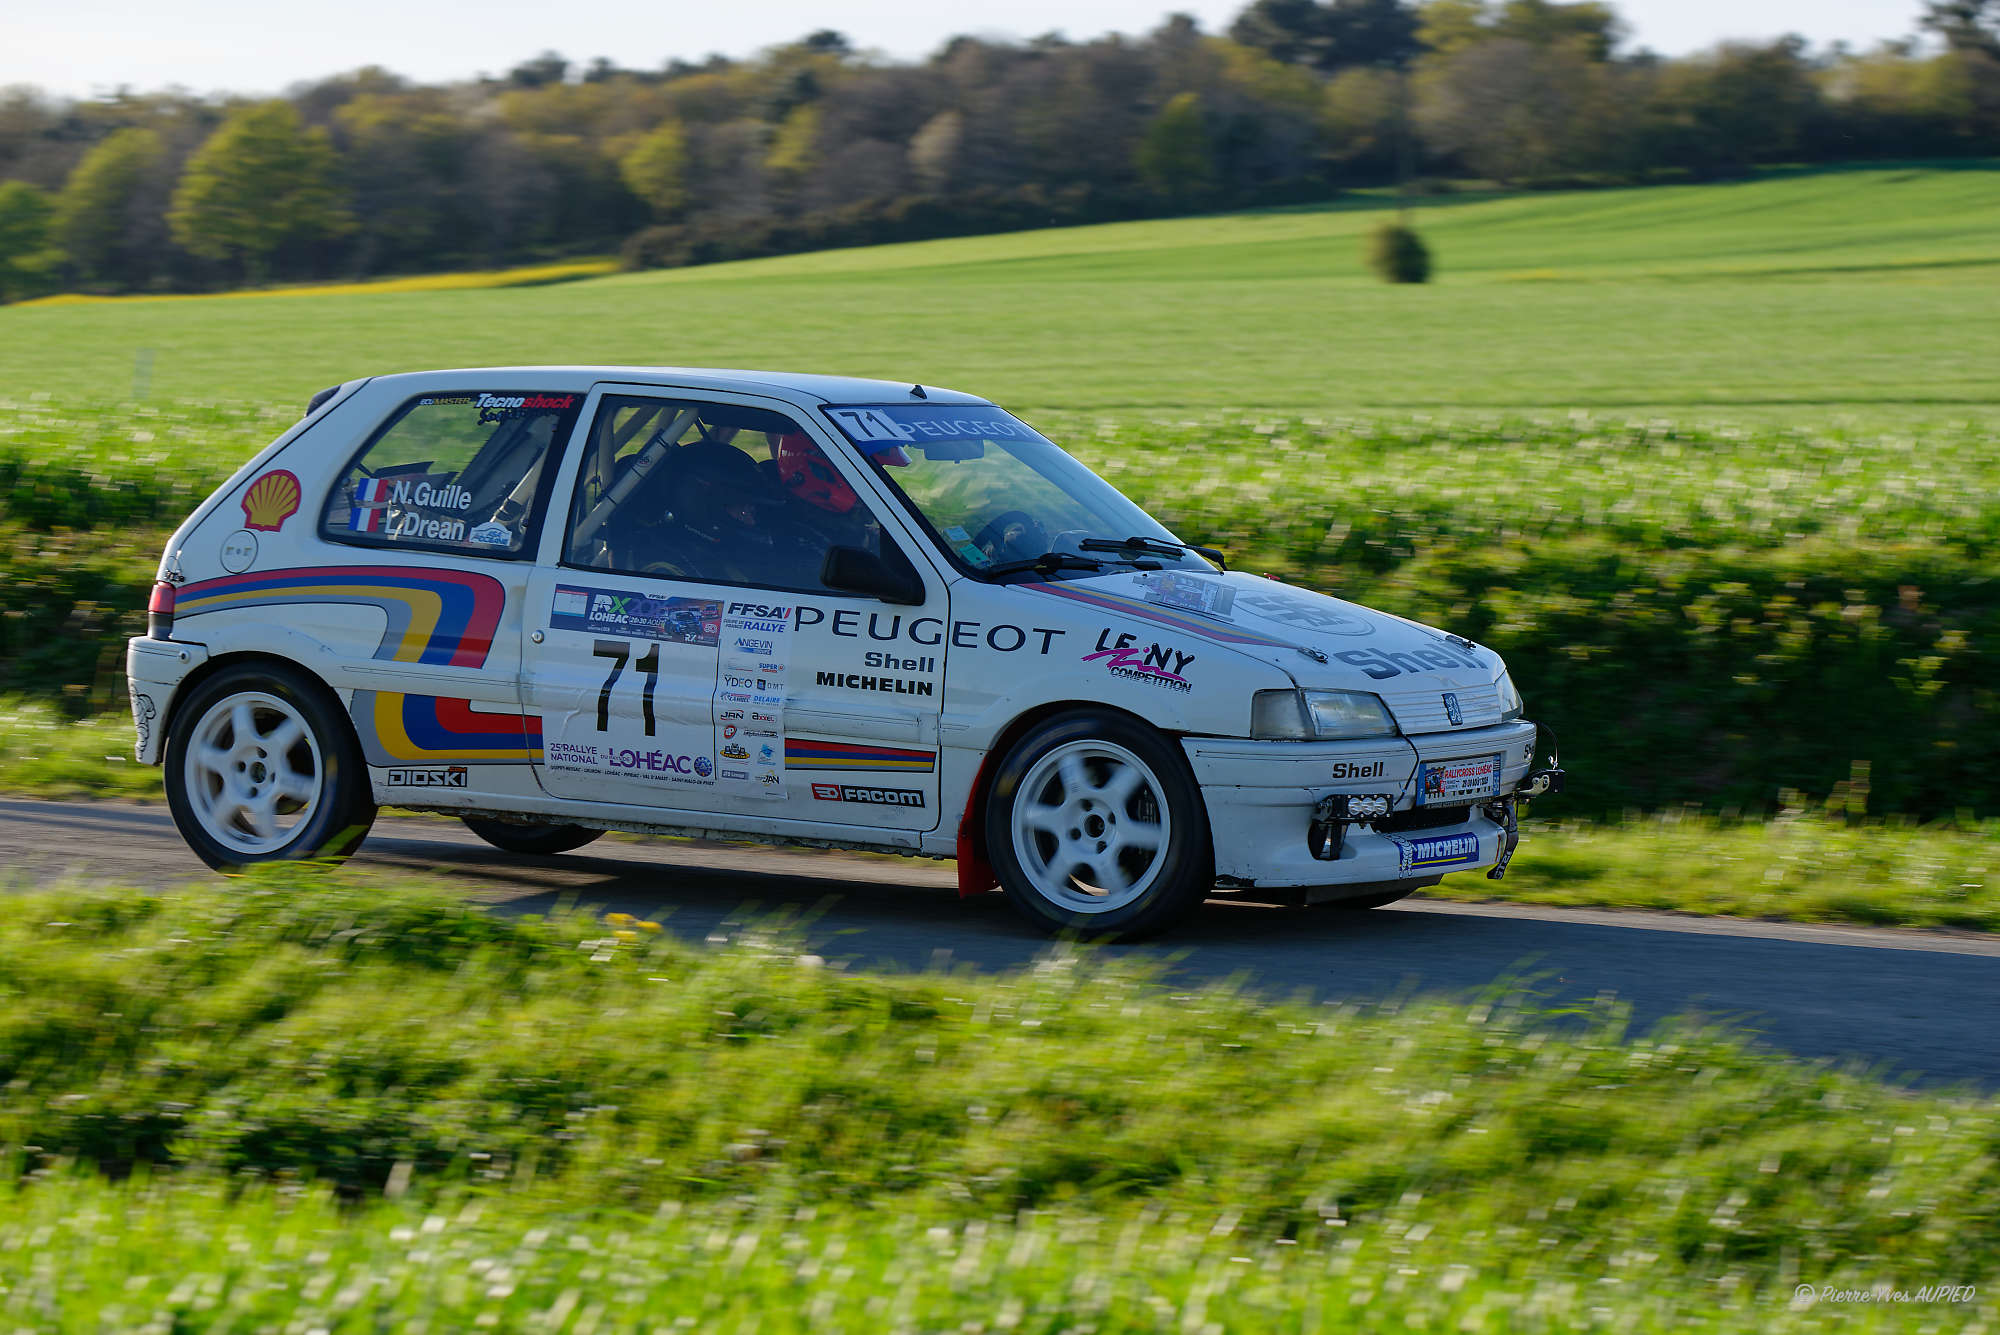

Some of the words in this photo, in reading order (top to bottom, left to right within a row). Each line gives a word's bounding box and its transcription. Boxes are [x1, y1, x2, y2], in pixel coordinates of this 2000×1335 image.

[475, 393, 575, 409] Tecnoshock
[840, 410, 900, 438] 71
[589, 611, 629, 625] LOHEAC
[727, 602, 783, 619] FFSA
[743, 620, 787, 633] RALLYE
[794, 605, 1066, 655] PEUGEOT
[734, 636, 774, 649] ANGEVIN
[864, 651, 934, 673] Shell
[1333, 643, 1489, 680] Shell
[593, 638, 660, 737] 71
[816, 671, 933, 696] MICHELIN
[1110, 666, 1193, 694] COMPETITION
[720, 711, 744, 720] JAN
[550, 753, 599, 765] NATIONAL
[608, 747, 692, 774] LOHÉAC
[388, 770, 467, 786] DIOSKI
[1332, 761, 1384, 779] Shell
[844, 788, 923, 805] FACOM
[1416, 836, 1477, 860] MICHELIN
